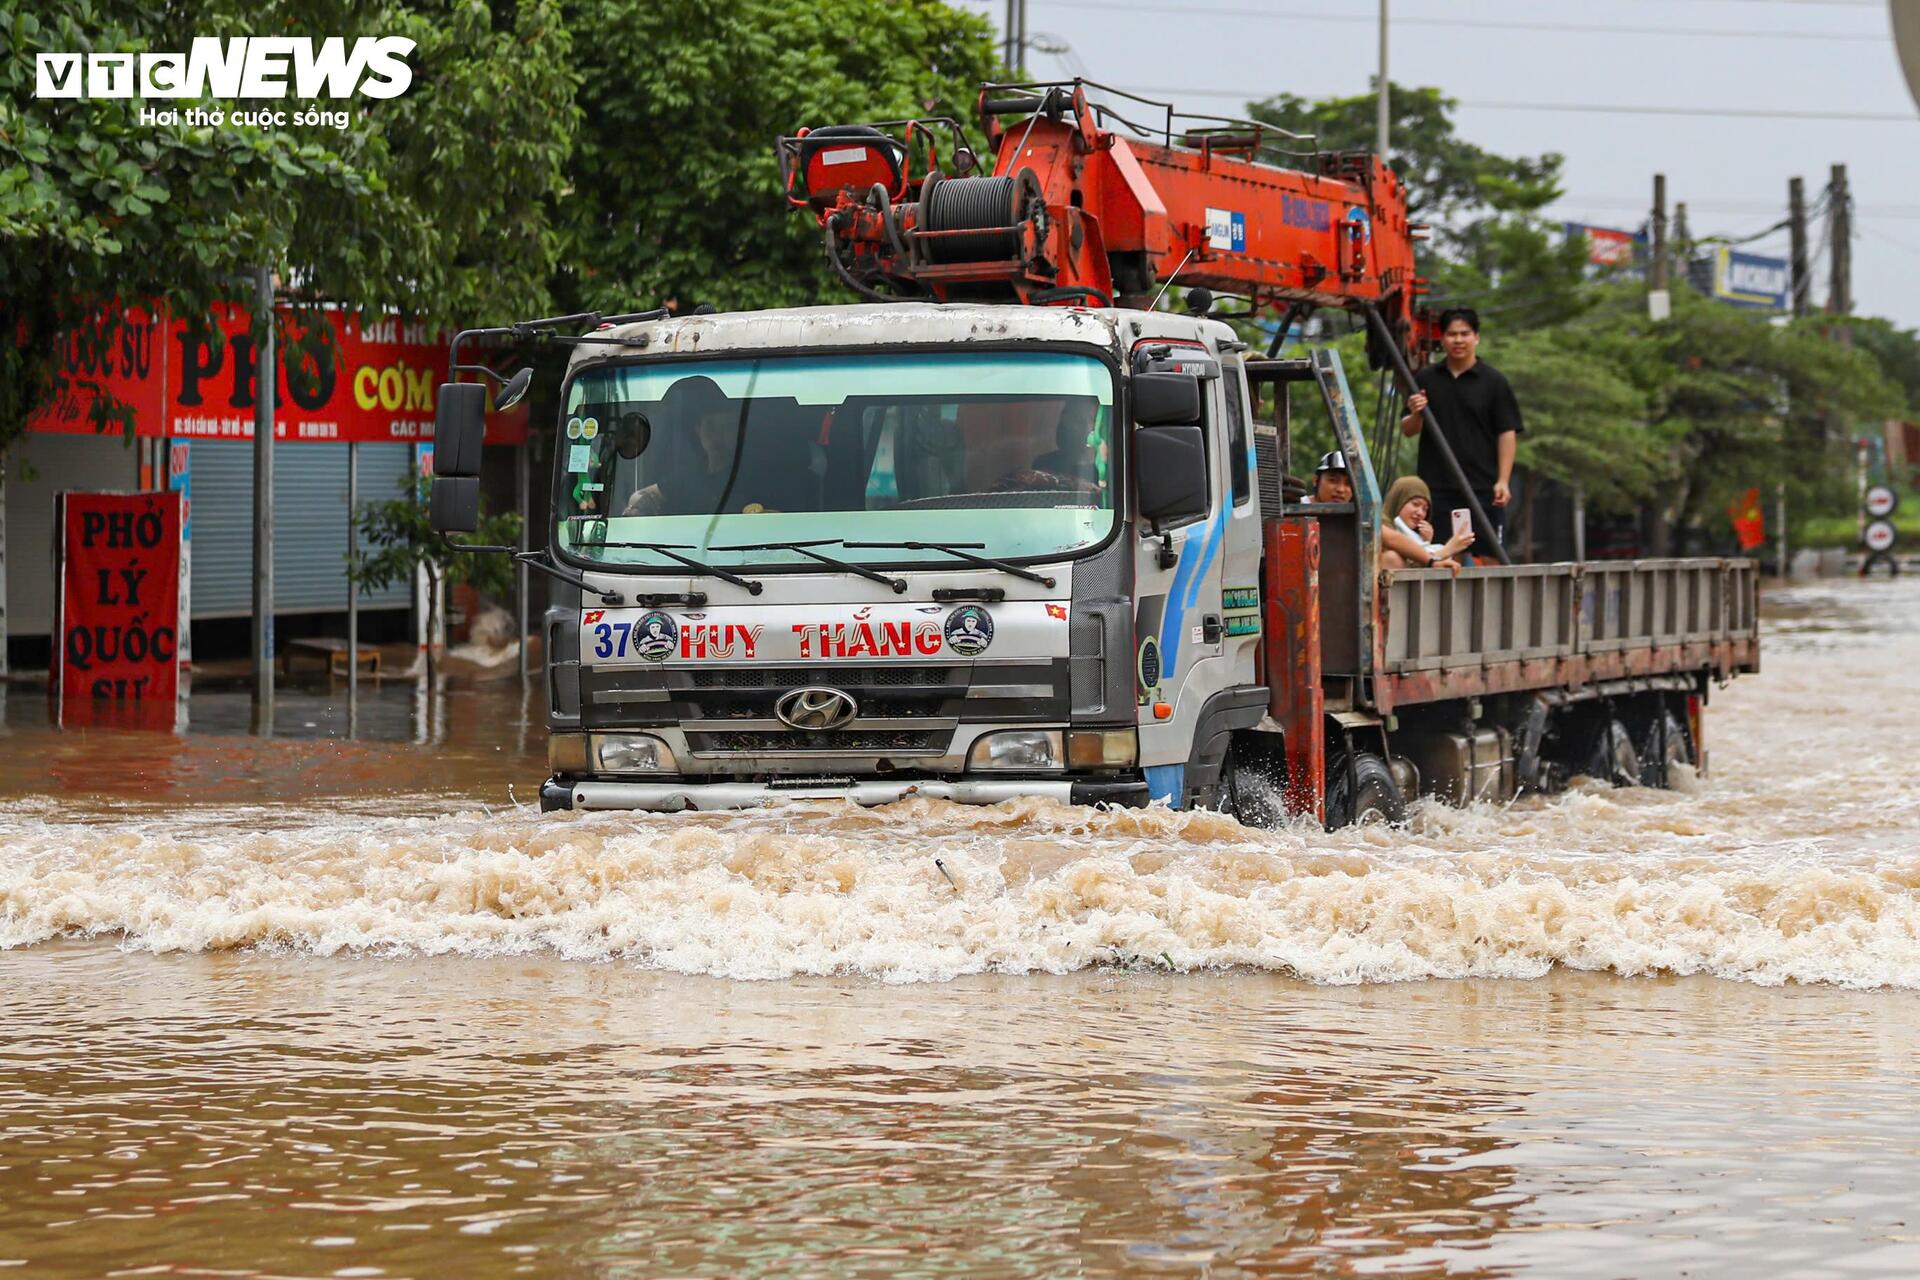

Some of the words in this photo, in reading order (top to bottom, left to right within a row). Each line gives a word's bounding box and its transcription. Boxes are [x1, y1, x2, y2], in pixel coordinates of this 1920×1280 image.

[353, 360, 434, 412] CƠM
[390, 418, 417, 437] CÁC
[82, 499, 164, 549] PHỞ
[96, 558, 148, 606] LÝ
[67, 611, 174, 670] QUỐC
[594, 622, 632, 659] 37
[681, 624, 765, 658] HUY
[792, 606, 942, 658] THẮNG
